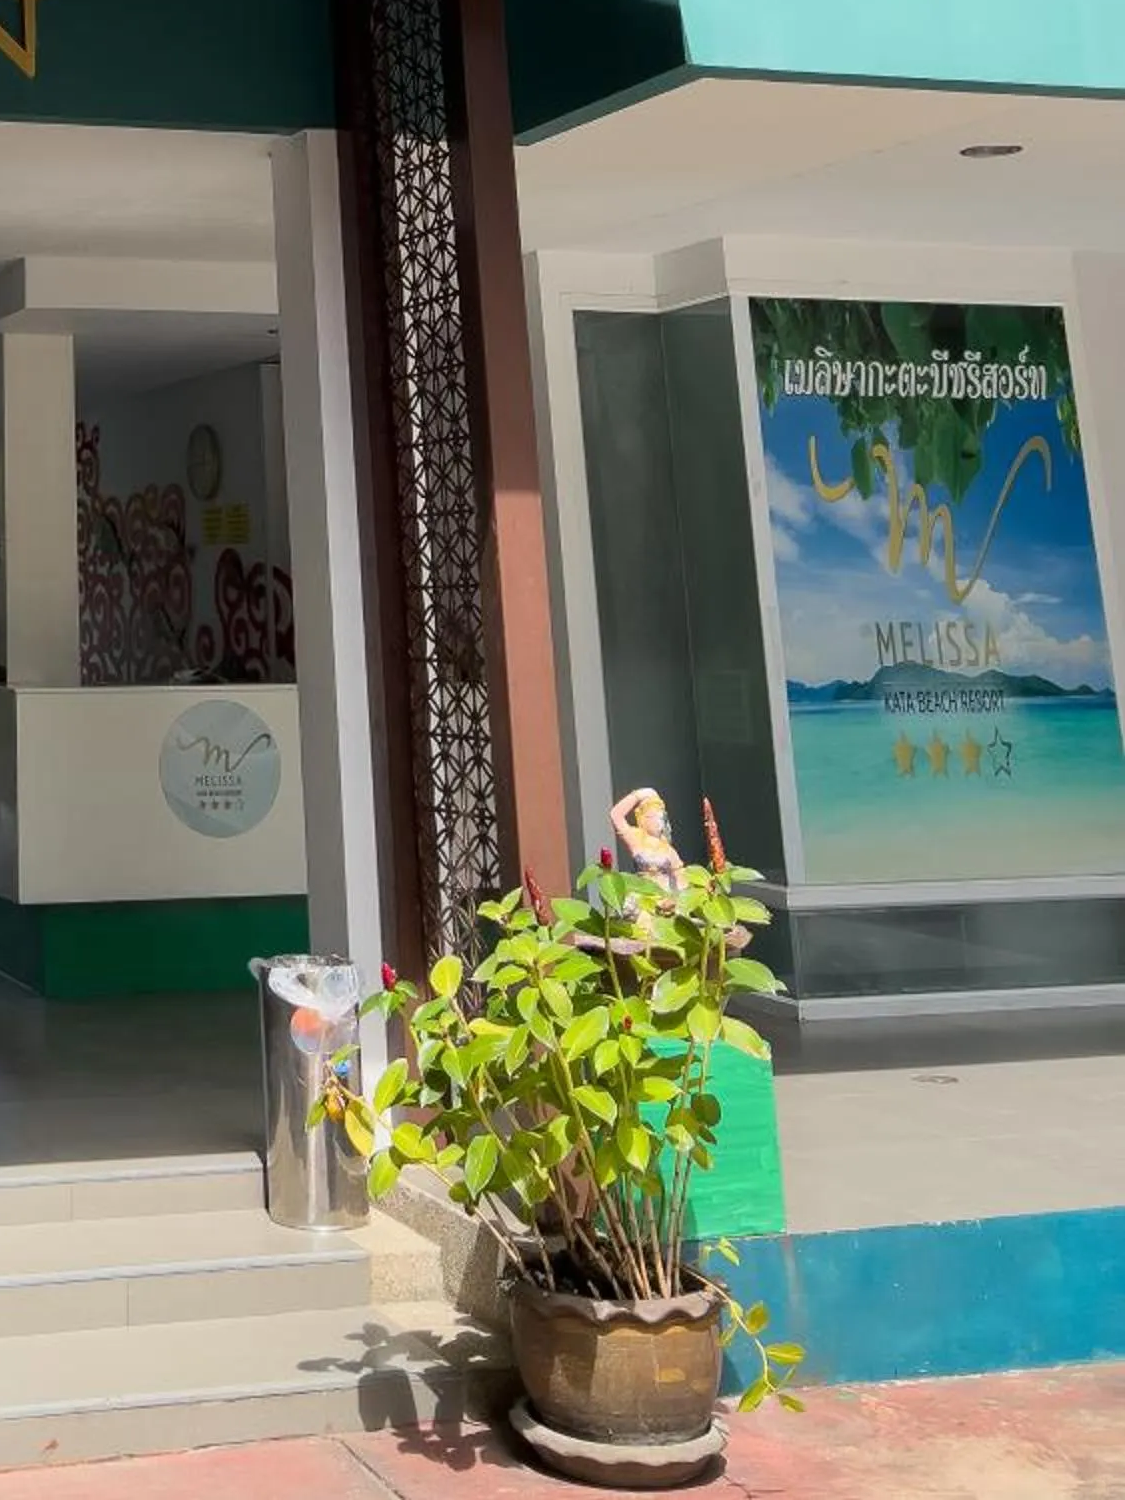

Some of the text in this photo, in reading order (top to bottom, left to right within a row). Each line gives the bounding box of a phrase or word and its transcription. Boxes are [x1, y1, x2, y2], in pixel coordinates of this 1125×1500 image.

[875, 620, 1002, 667] MELISSA
[883, 689, 1005, 714] KATA BEACH RESORT
